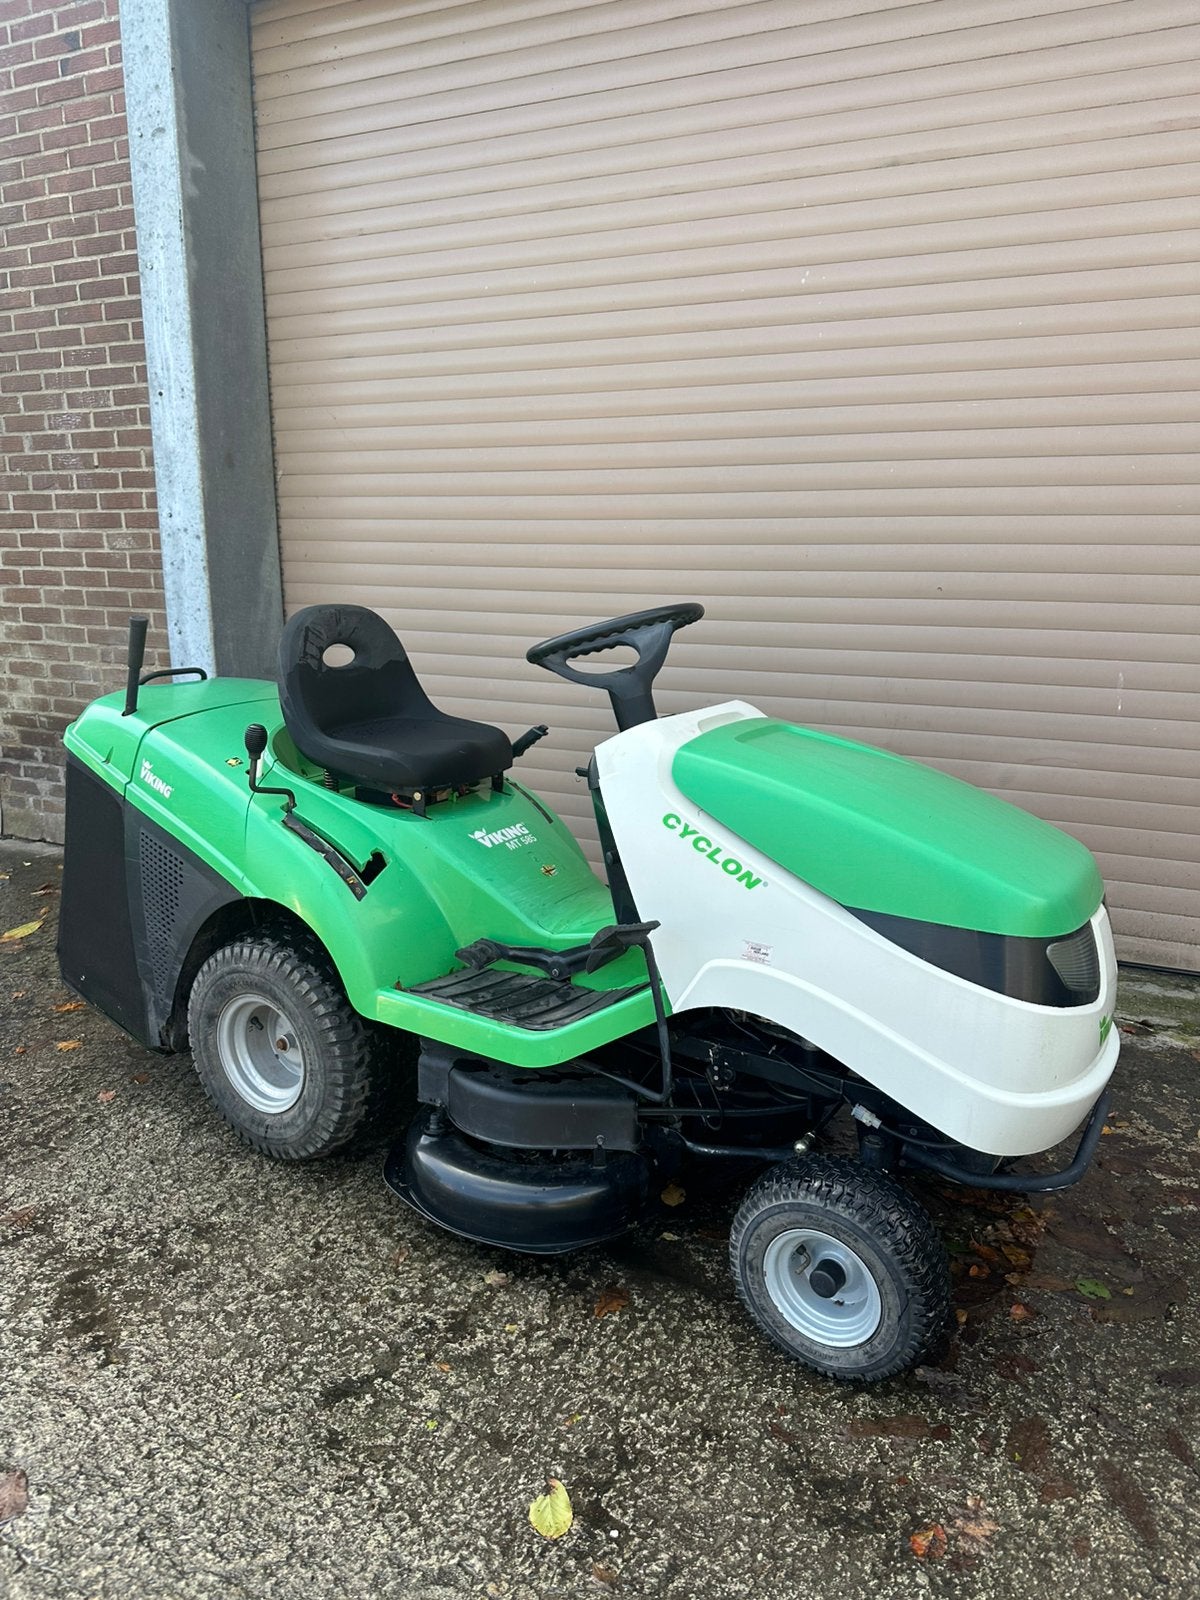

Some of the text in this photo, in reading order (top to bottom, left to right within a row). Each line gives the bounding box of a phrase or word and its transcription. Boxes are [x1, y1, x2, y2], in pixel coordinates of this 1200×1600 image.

[141, 765, 172, 799] VIKING
[477, 823, 529, 848] VIKING
[505, 834, 537, 851] MT 585
[662, 813, 763, 890] CYCLON
